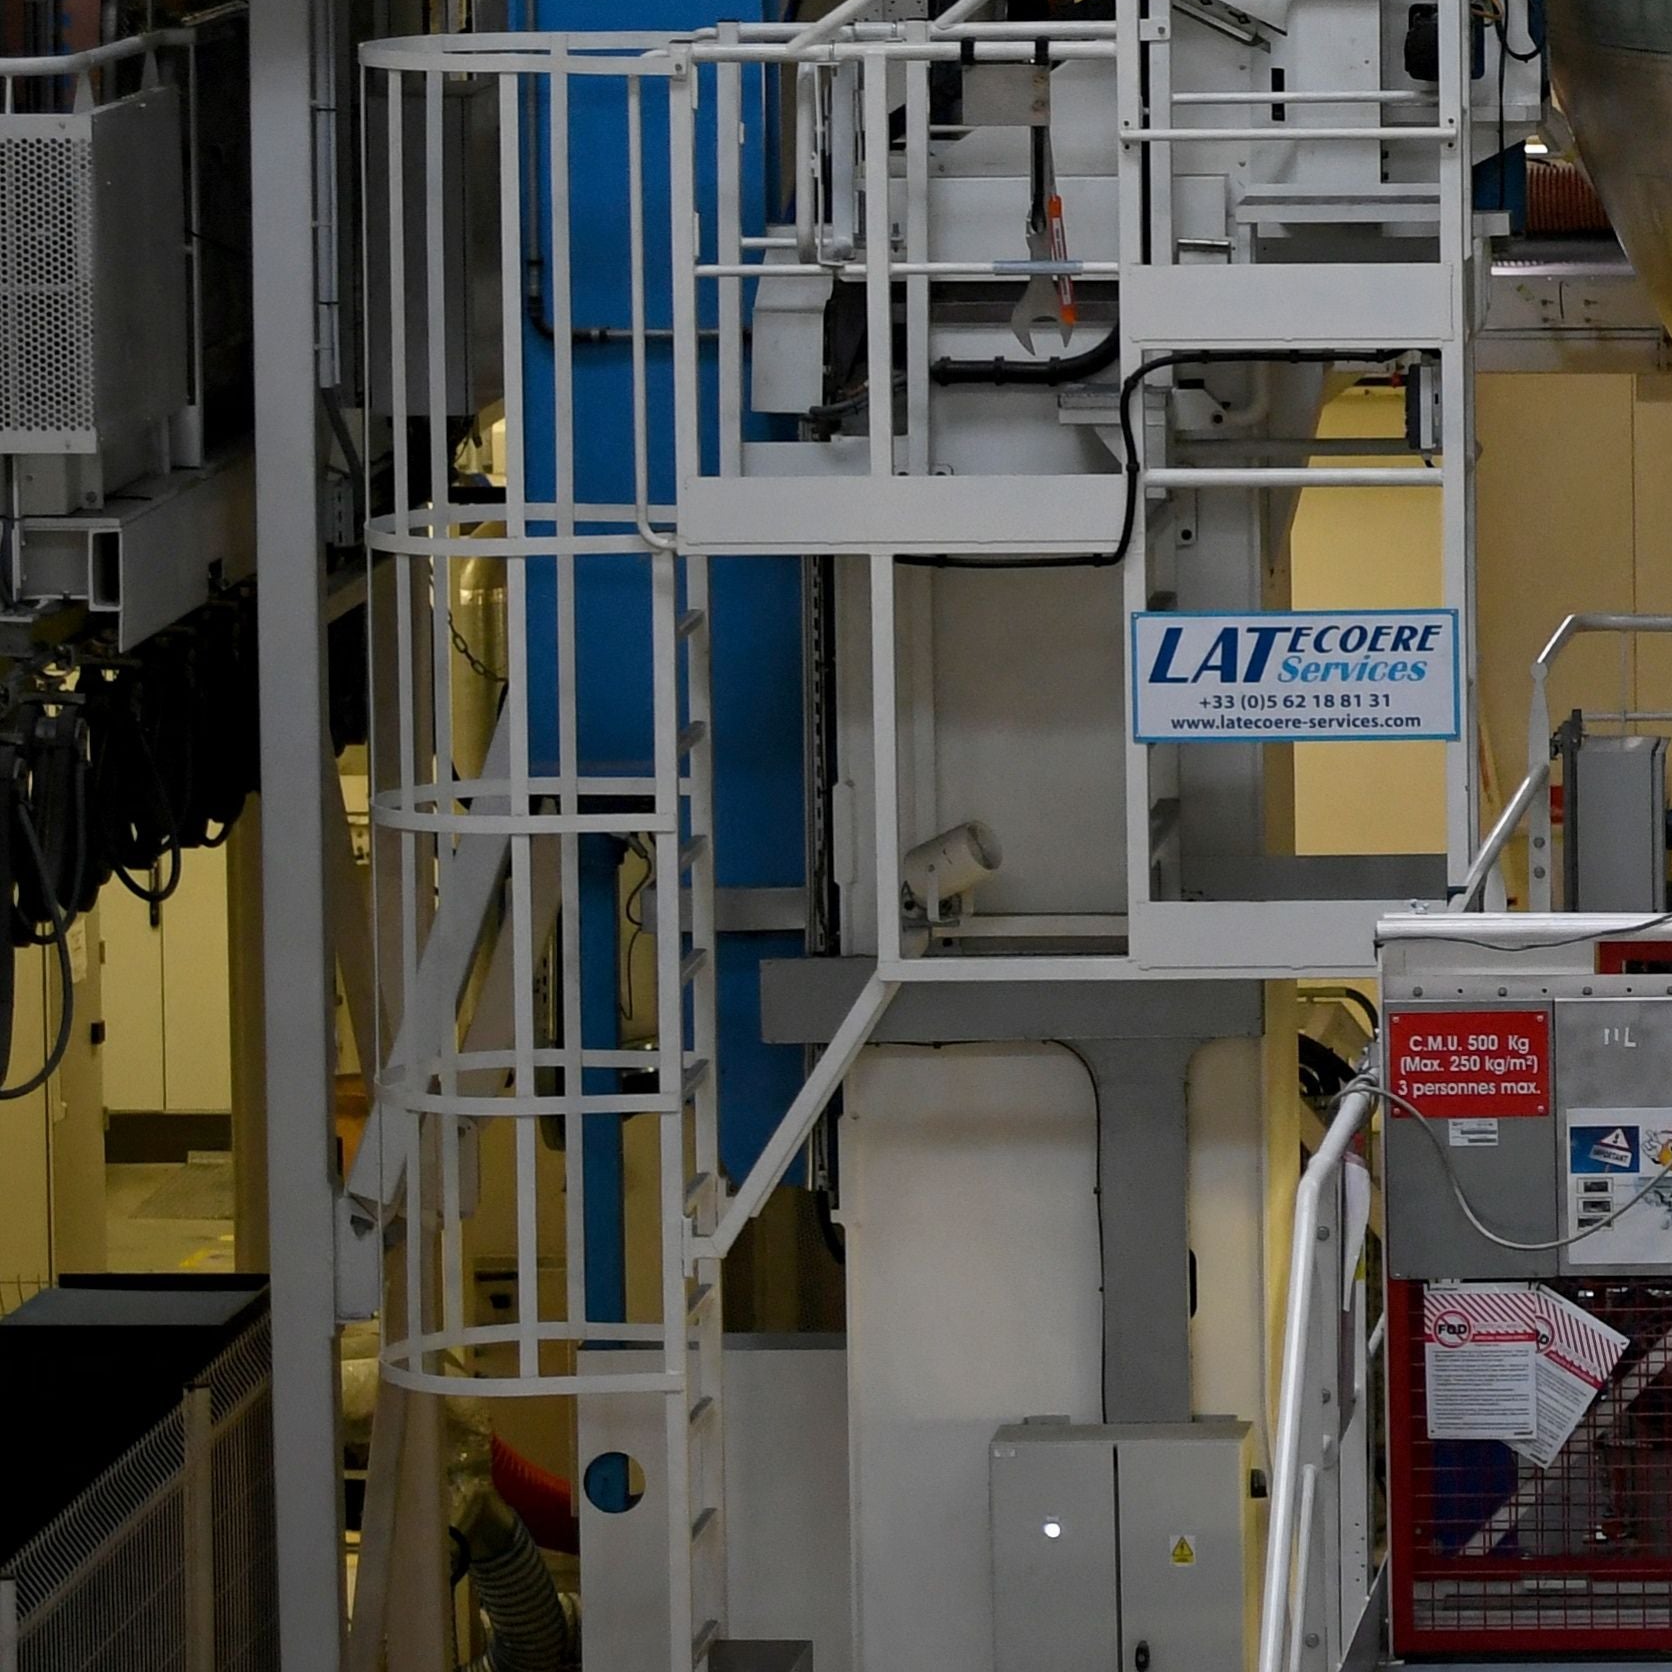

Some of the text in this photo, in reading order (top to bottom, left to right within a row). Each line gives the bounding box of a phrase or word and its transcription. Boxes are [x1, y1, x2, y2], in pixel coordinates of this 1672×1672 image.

[1277, 654, 1428, 683] Services
[1199, 693, 1391, 710] +33 (0)5 62 18 81 31
[1171, 714, 1422, 730] www.latecoere-services.com
[1409, 1035, 1530, 1054] C.M.U. 500 Kg
[1400, 1056, 1444, 1075] (Max.
[1450, 1055, 1480, 1071] 250
[1398, 1080, 1541, 1098] 3 personnes max.
